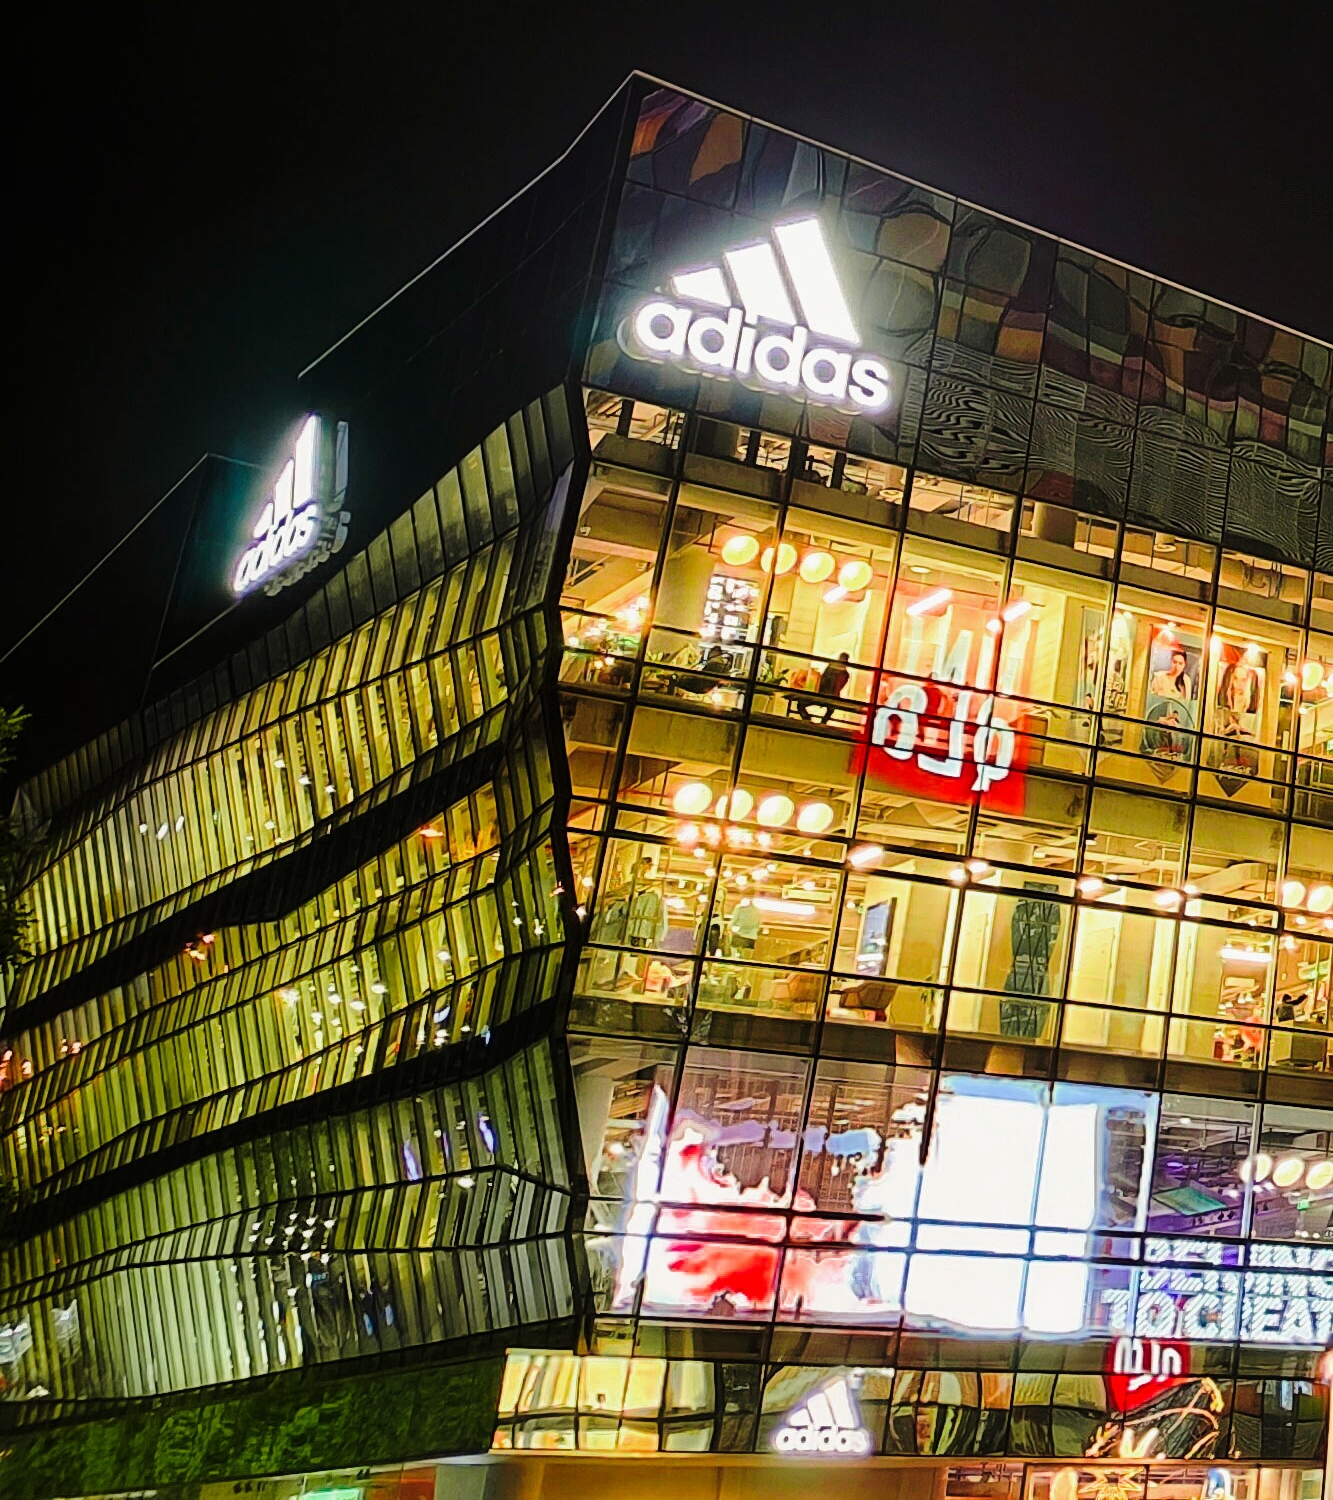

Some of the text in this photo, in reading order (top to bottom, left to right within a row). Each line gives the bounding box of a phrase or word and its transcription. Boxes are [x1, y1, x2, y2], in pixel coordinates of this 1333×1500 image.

[635, 301, 890, 407] adidas
[232, 504, 319, 593] adidas
[1101, 1288, 1177, 1338] TO
[775, 1424, 867, 1453] adidas
